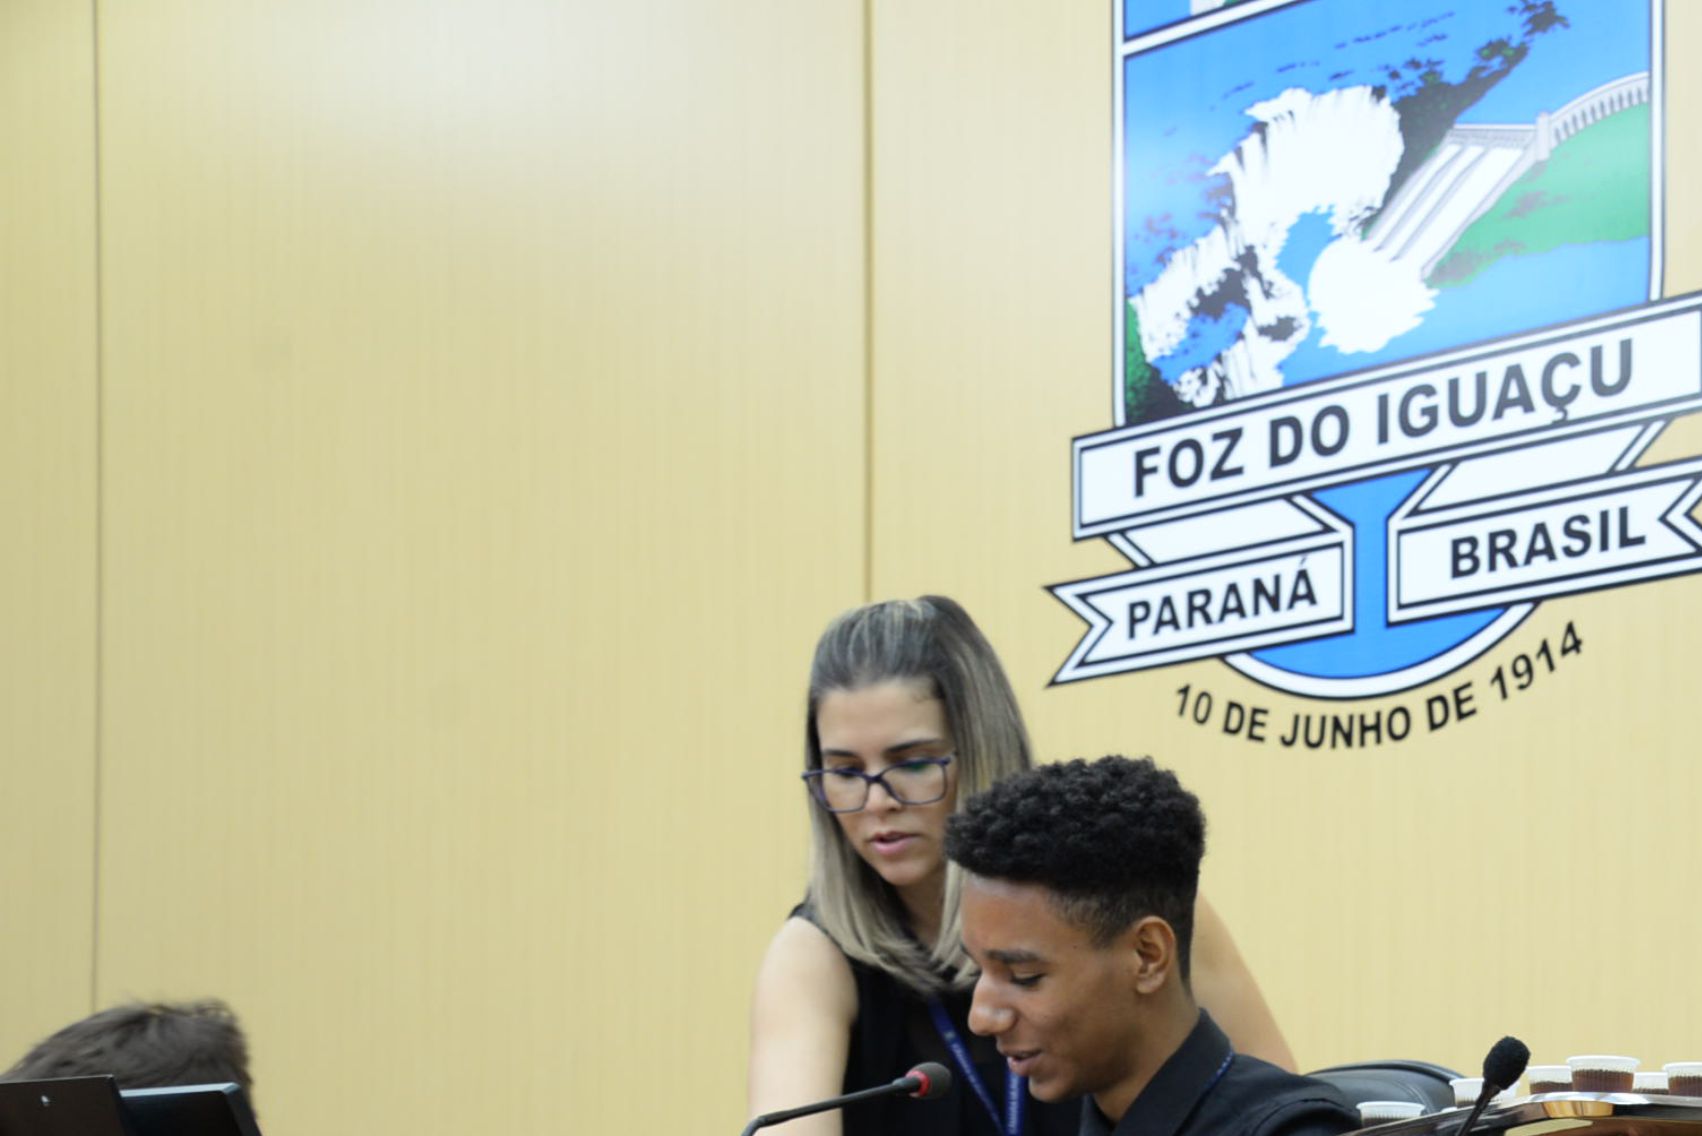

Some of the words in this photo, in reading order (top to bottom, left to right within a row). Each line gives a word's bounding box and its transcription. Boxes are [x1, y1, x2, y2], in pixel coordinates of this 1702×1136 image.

[1133, 428, 1244, 499] FOZ
[1269, 404, 1350, 468] DO
[1377, 337, 1634, 446] IGUAÇU
[1450, 505, 1646, 579] BRASIL
[1127, 557, 1318, 640] PARANÁ
[1175, 683, 1213, 726] 10
[1222, 699, 1269, 742] DE
[1280, 706, 1412, 750] JUNHO
[1427, 682, 1477, 732] DE
[1490, 620, 1584, 701] 1914
